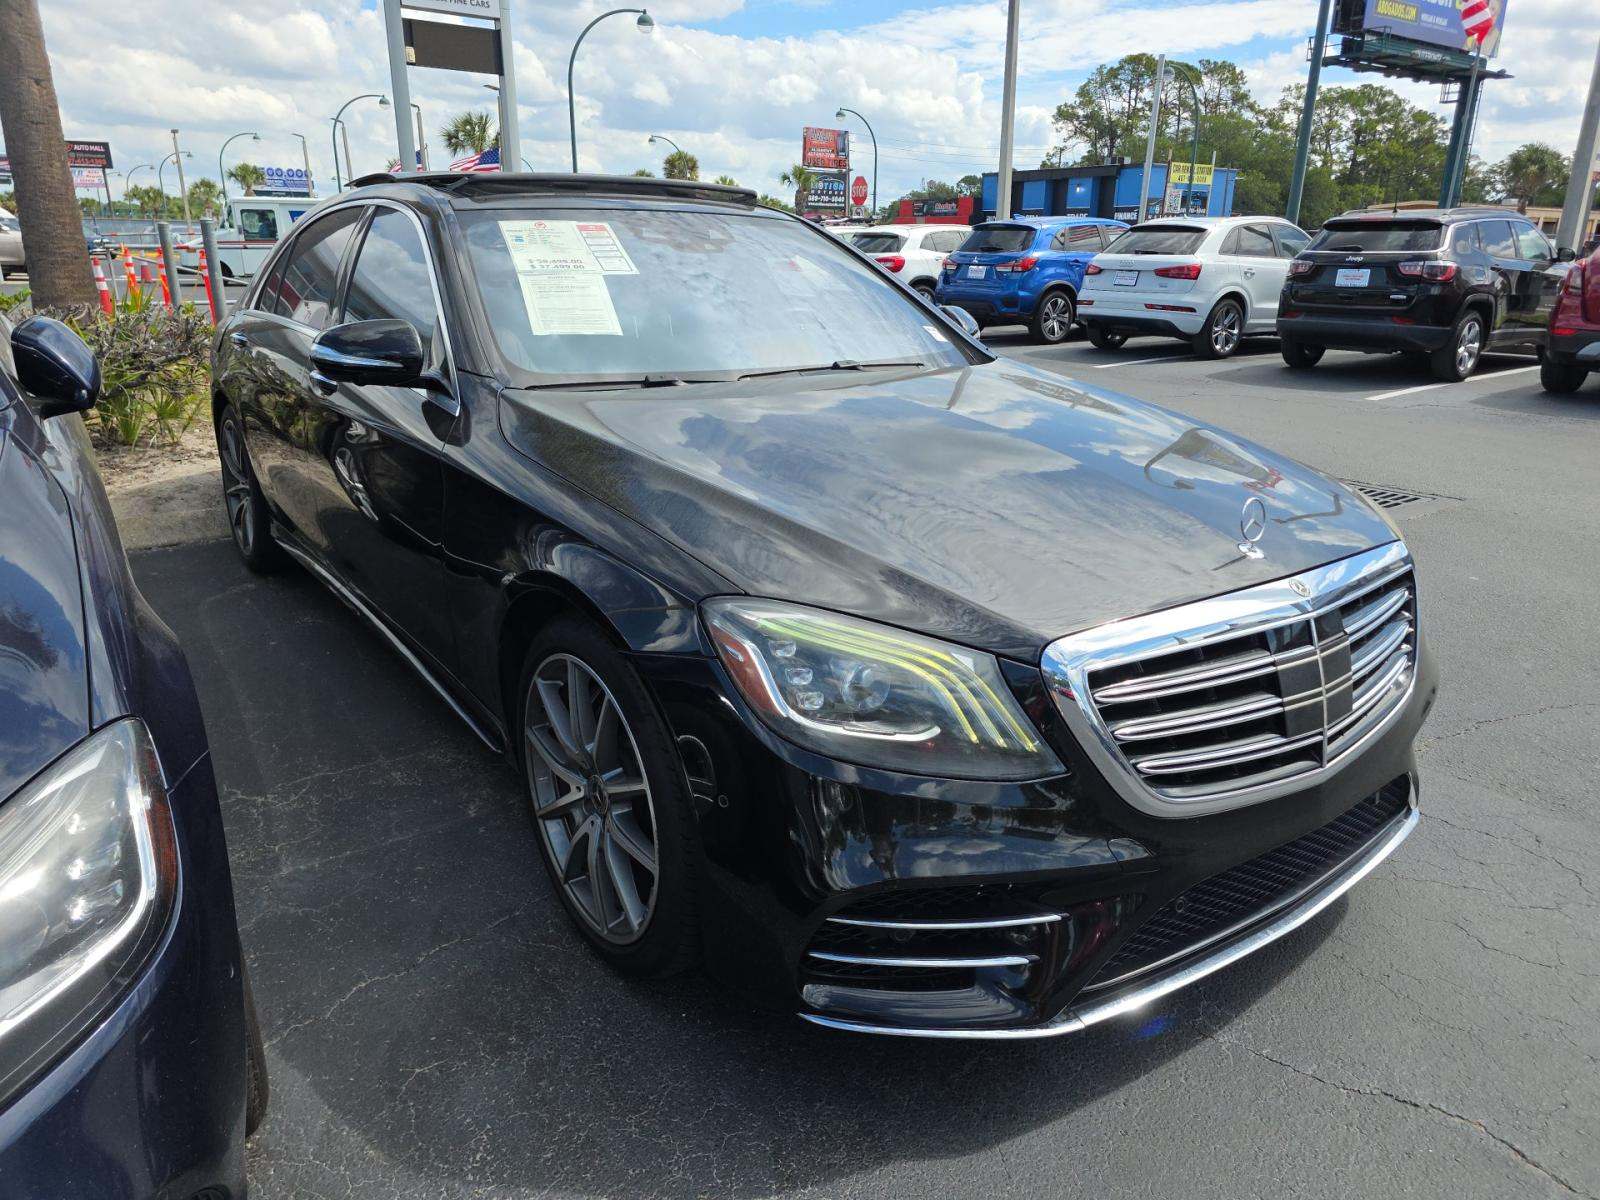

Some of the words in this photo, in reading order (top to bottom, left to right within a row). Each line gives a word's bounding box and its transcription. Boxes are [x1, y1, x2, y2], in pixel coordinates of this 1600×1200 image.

[470, 0, 490, 8] CARS
[1377, 0, 1417, 20] ABOGADOS.COM
[807, 157, 825, 166] USED
[829, 158, 847, 167] TIRES
[852, 185, 868, 198] STOP
